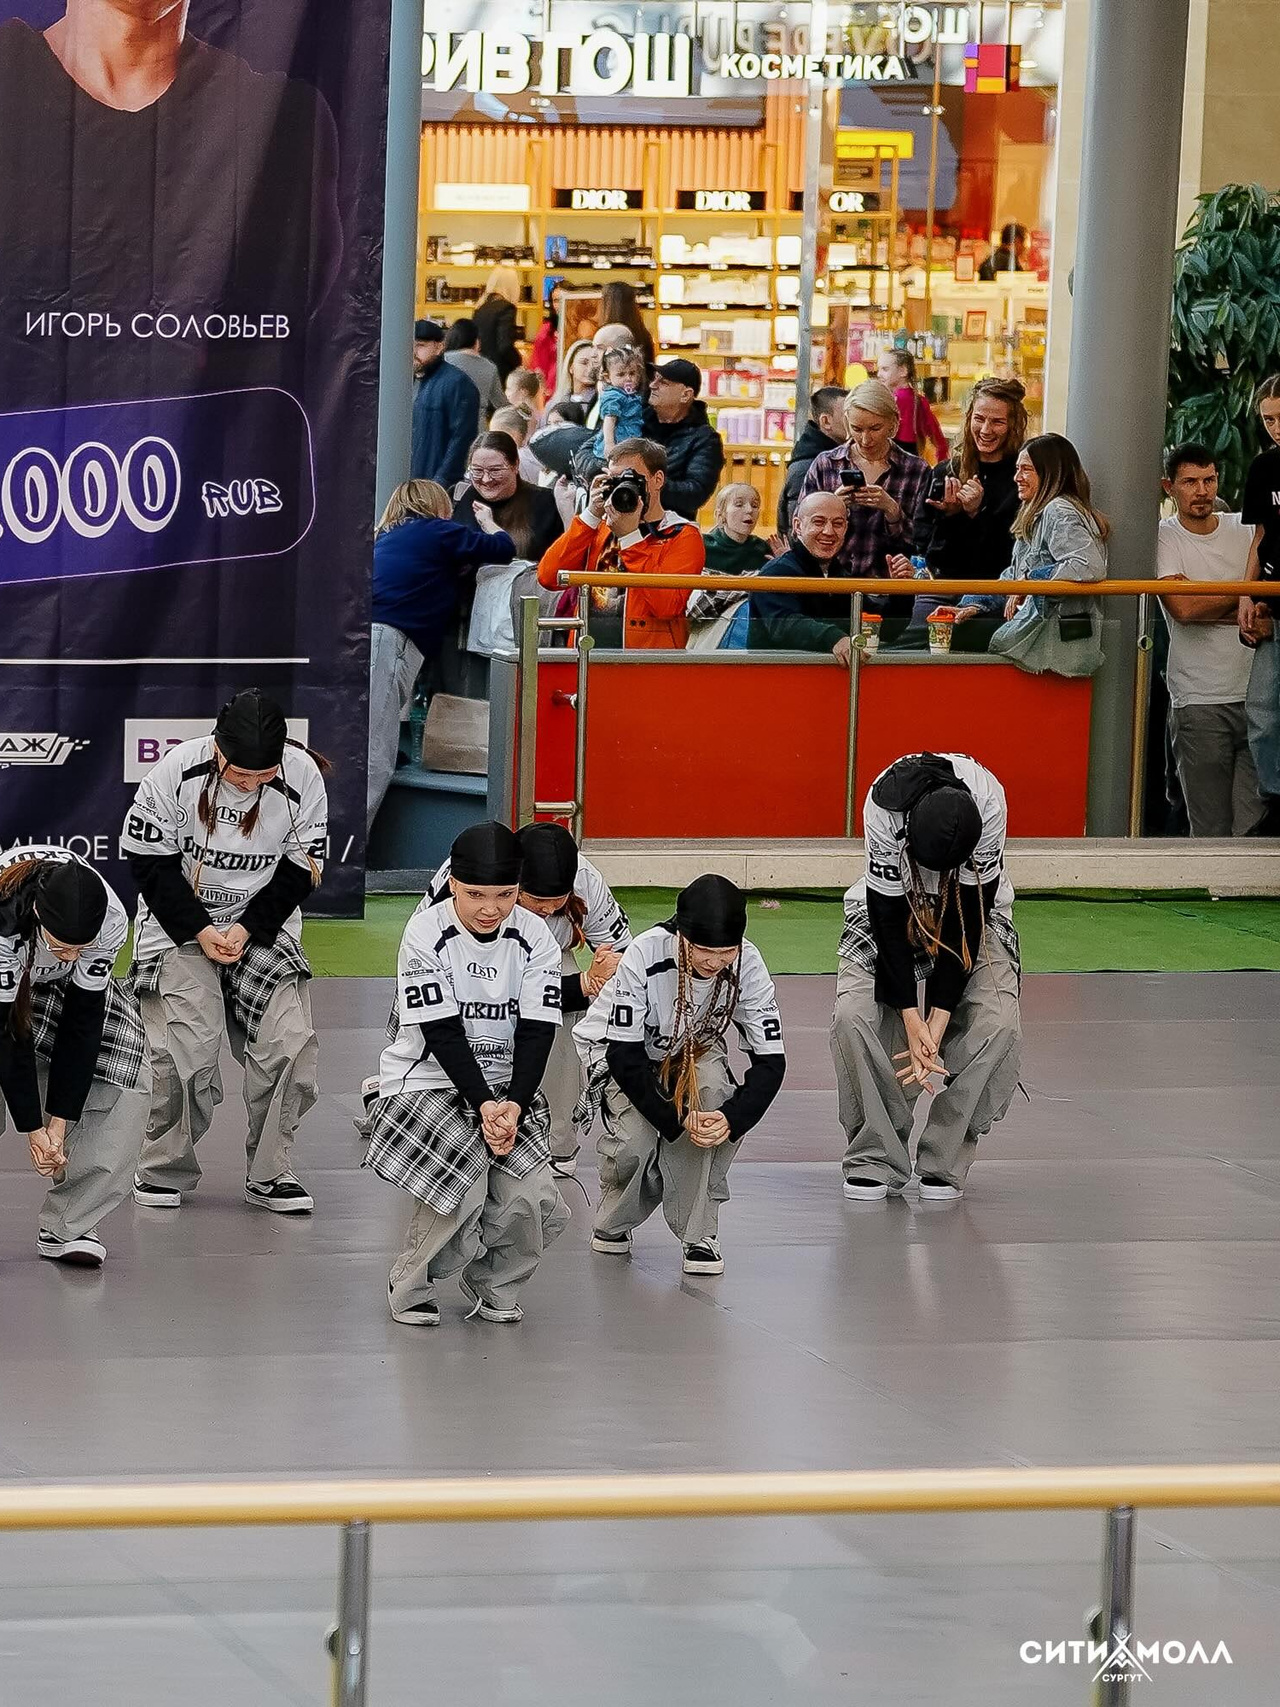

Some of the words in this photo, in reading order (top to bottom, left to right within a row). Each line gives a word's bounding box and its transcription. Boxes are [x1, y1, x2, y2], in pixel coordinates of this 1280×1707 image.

[899, 6, 970, 43] ОШ
[541, 30, 692, 97] ГОШ
[720, 53, 905, 81] КОСМЕТИКА
[572, 189, 628, 210] DIOR
[695, 190, 751, 211] DIOR
[829, 191, 865, 212] OR
[25, 312, 121, 337] ИГОРЬ
[131, 313, 290, 338] СОЛОВЬЕВ
[201, 479, 283, 518] RUB
[405, 982, 443, 1009] 20
[762, 1019, 781, 1041] 2
